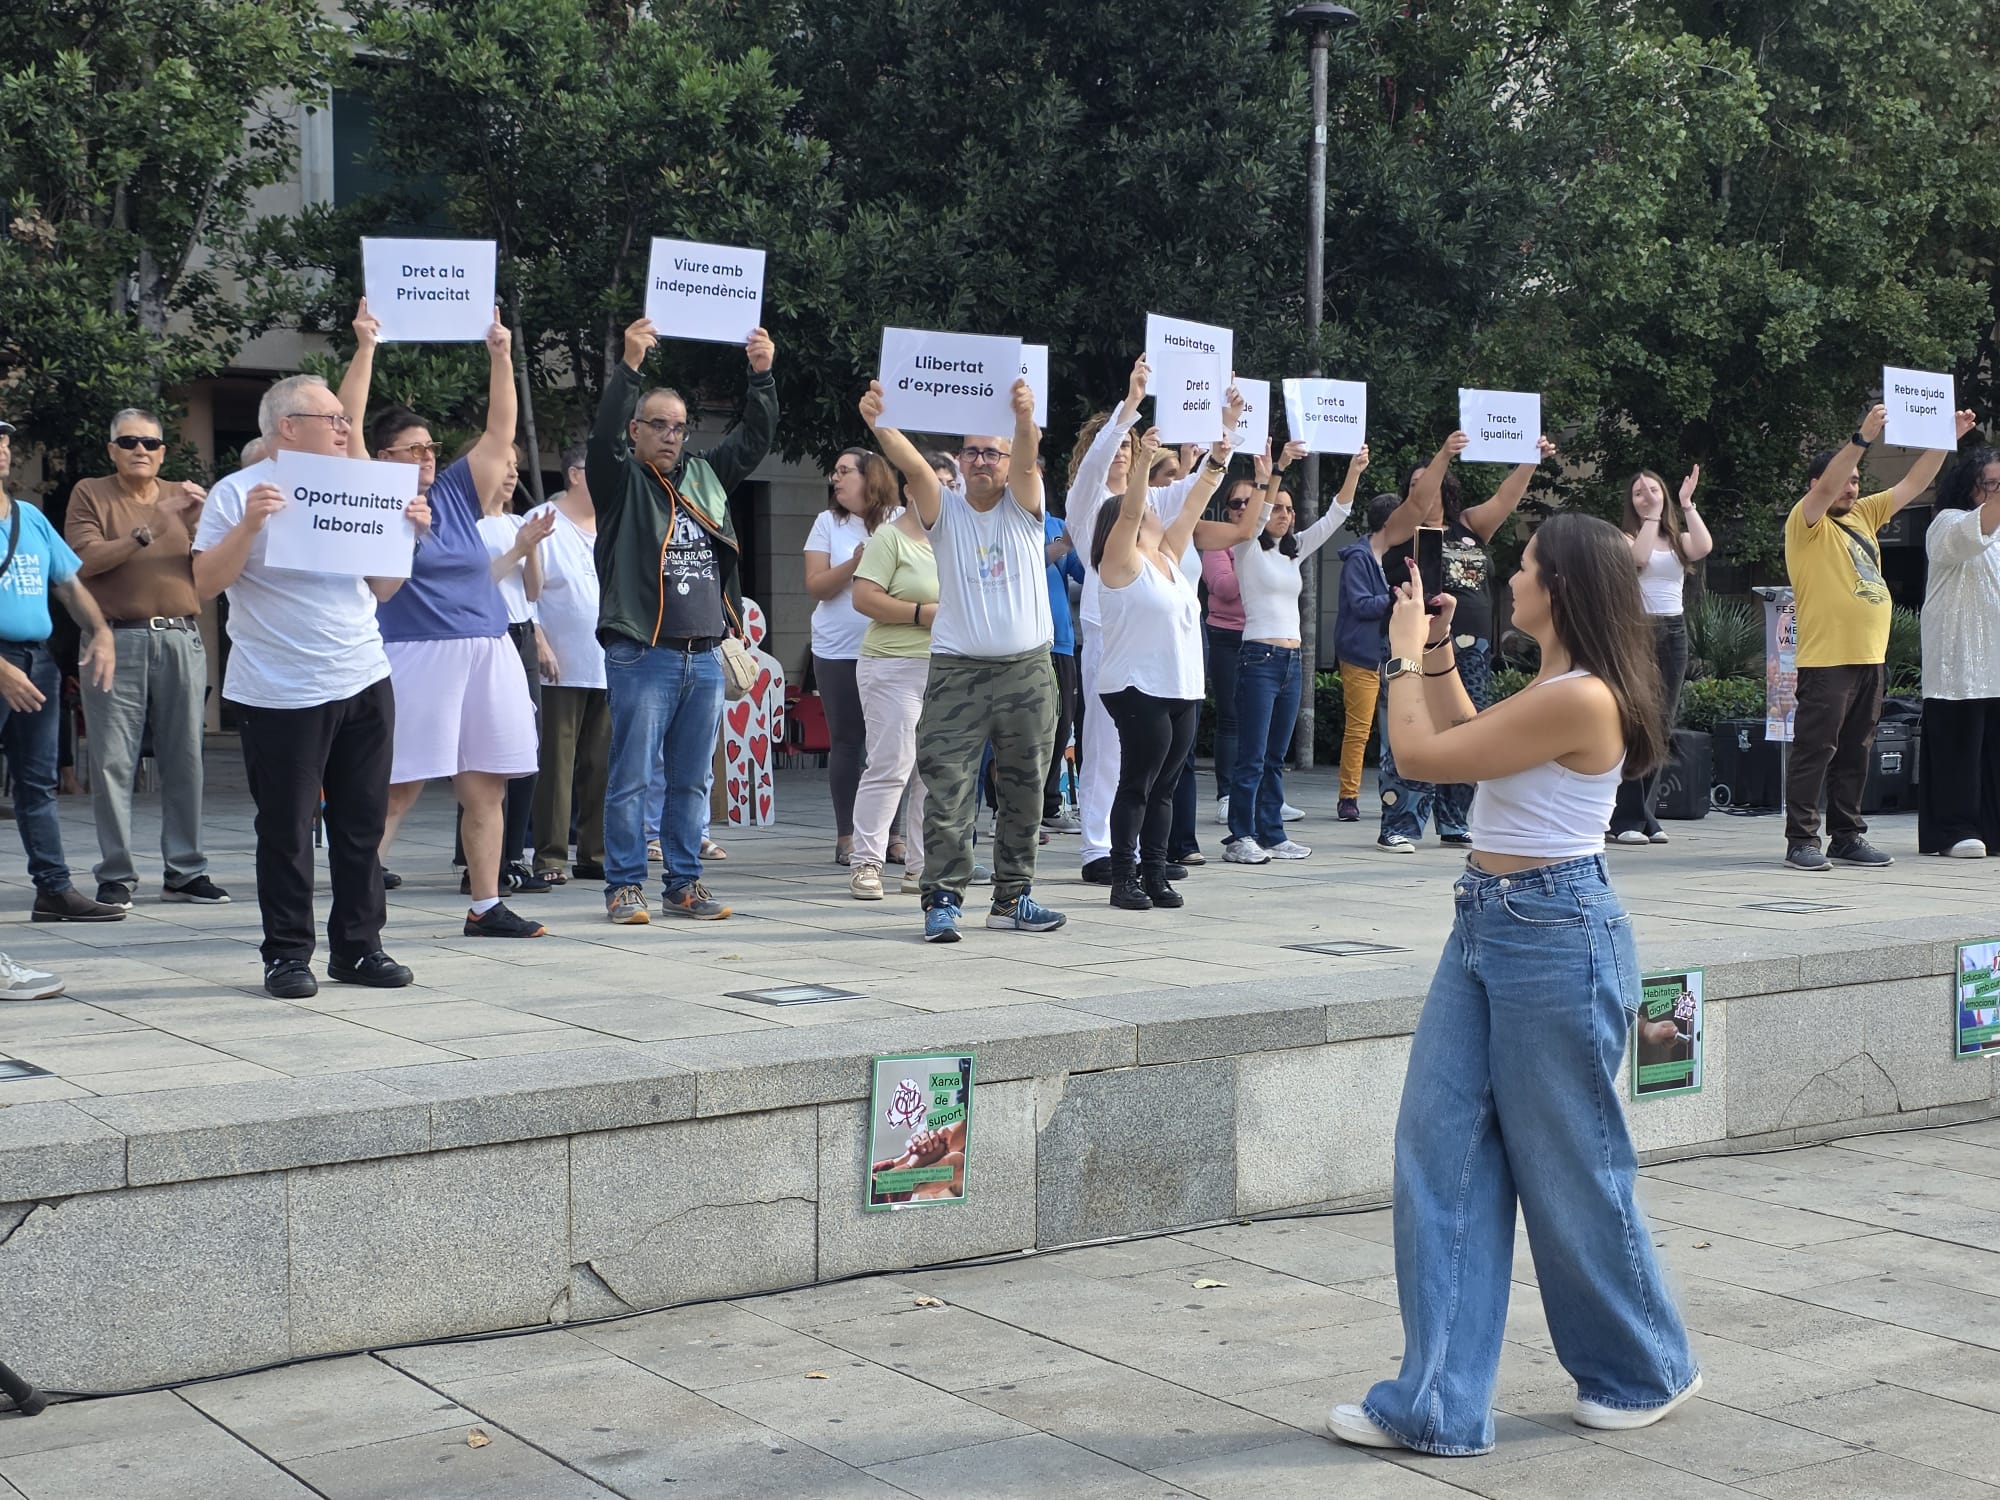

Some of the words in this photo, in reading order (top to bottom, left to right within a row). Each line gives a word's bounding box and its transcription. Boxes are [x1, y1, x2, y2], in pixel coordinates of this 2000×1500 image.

[402, 265, 435, 278] Dret
[439, 268, 448, 278] a
[452, 265, 465, 278] la
[674, 258, 709, 273] Viure
[712, 264, 743, 277] amb
[397, 287, 471, 301] Privacitat
[656, 276, 757, 300] independència
[1164, 334, 1215, 352] Habitatge
[915, 355, 984, 374] Llibertat
[1186, 380, 1204, 391] Dret
[1894, 384, 1919, 395] Rebre
[1920, 387, 1945, 400] ajuda
[1182, 399, 1211, 411] decidir
[1317, 396, 1338, 406] Dret
[1338, 399, 1345, 407] a
[1905, 401, 1908, 412] i
[1909, 404, 1937, 416] suport
[1304, 412, 1322, 421] Ser
[1323, 414, 1358, 424] escoltat
[1487, 413, 1517, 423] Tracte
[1480, 428, 1523, 441] igualitari
[294, 487, 403, 510] Oportunitats
[313, 514, 384, 535] laborals
[1965, 998, 1997, 1009] emocional
[931, 1077, 960, 1087] Xarxa
[934, 1095, 949, 1105] de
[928, 1109, 963, 1127] suport
